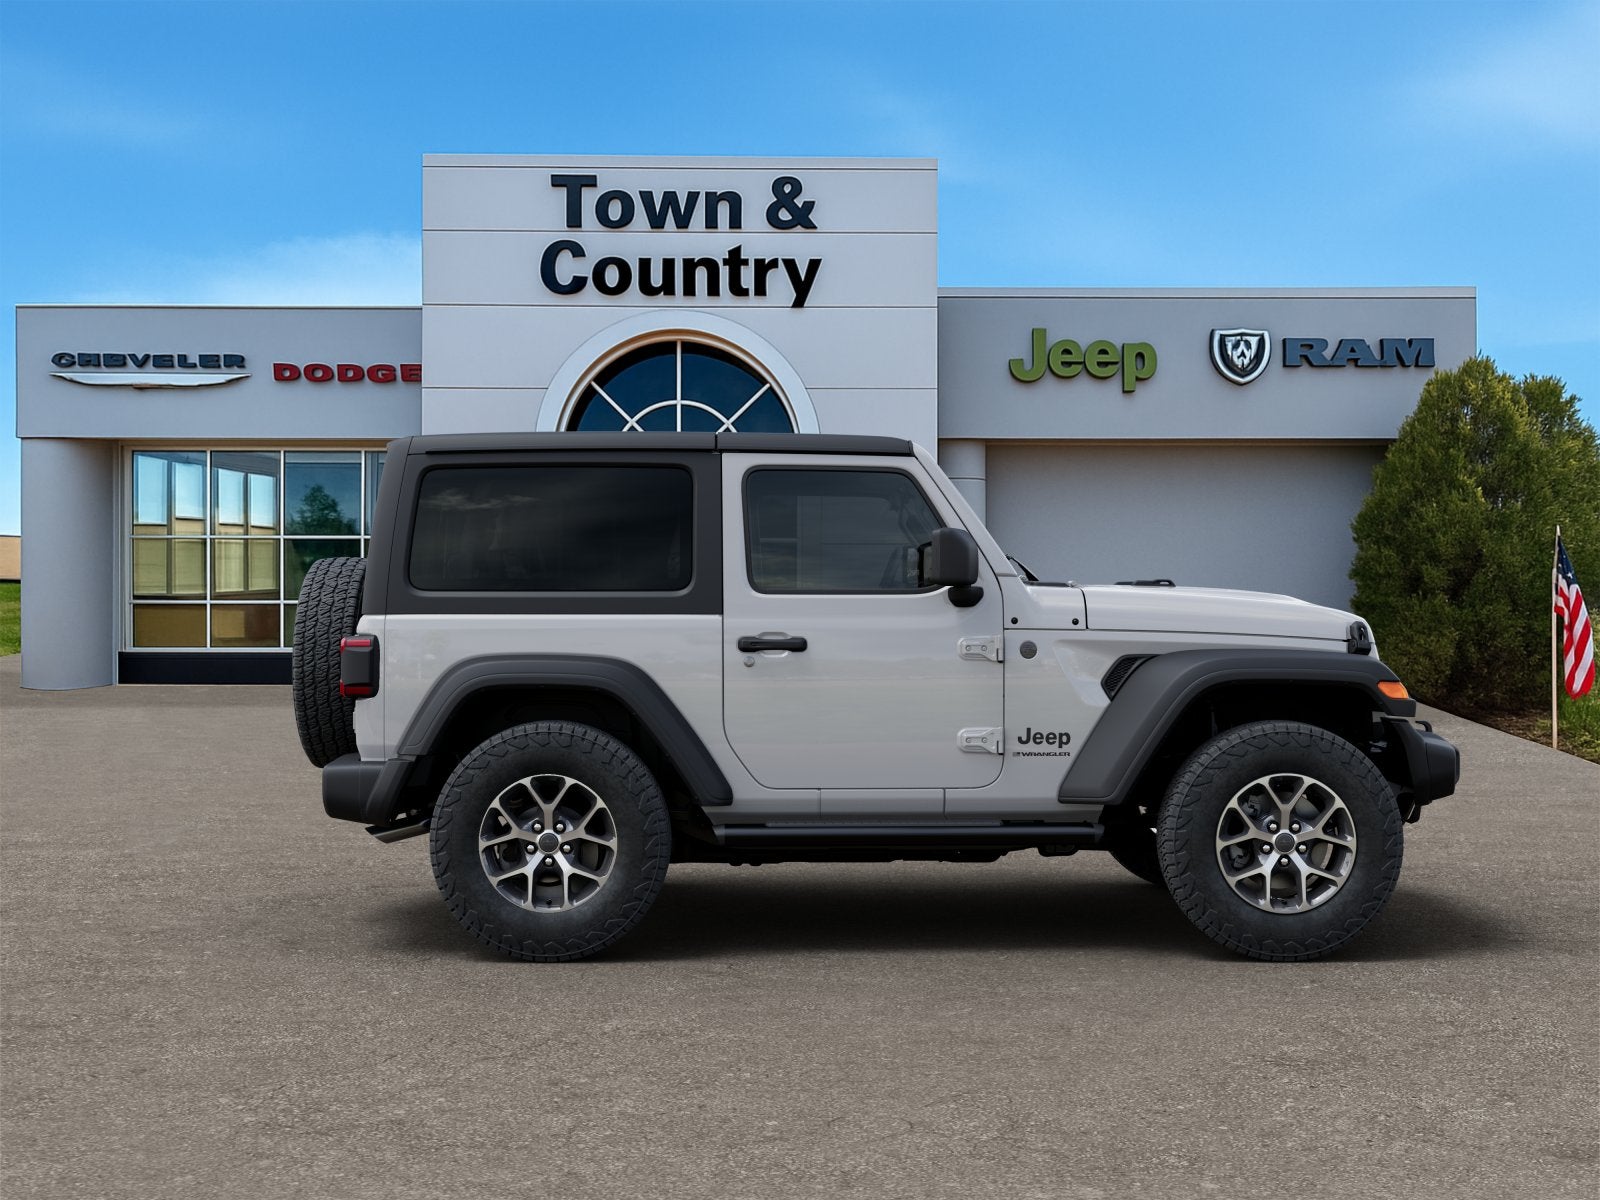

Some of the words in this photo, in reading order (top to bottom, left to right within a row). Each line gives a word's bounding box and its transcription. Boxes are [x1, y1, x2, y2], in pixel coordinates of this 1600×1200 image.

[550, 174, 743, 230] Town
[765, 175, 818, 231] &
[540, 239, 823, 308] Country
[272, 362, 422, 383] DODGE
[1009, 327, 1158, 393] Jeep
[1283, 337, 1435, 368] RAM
[1017, 727, 1071, 749] Jeep
